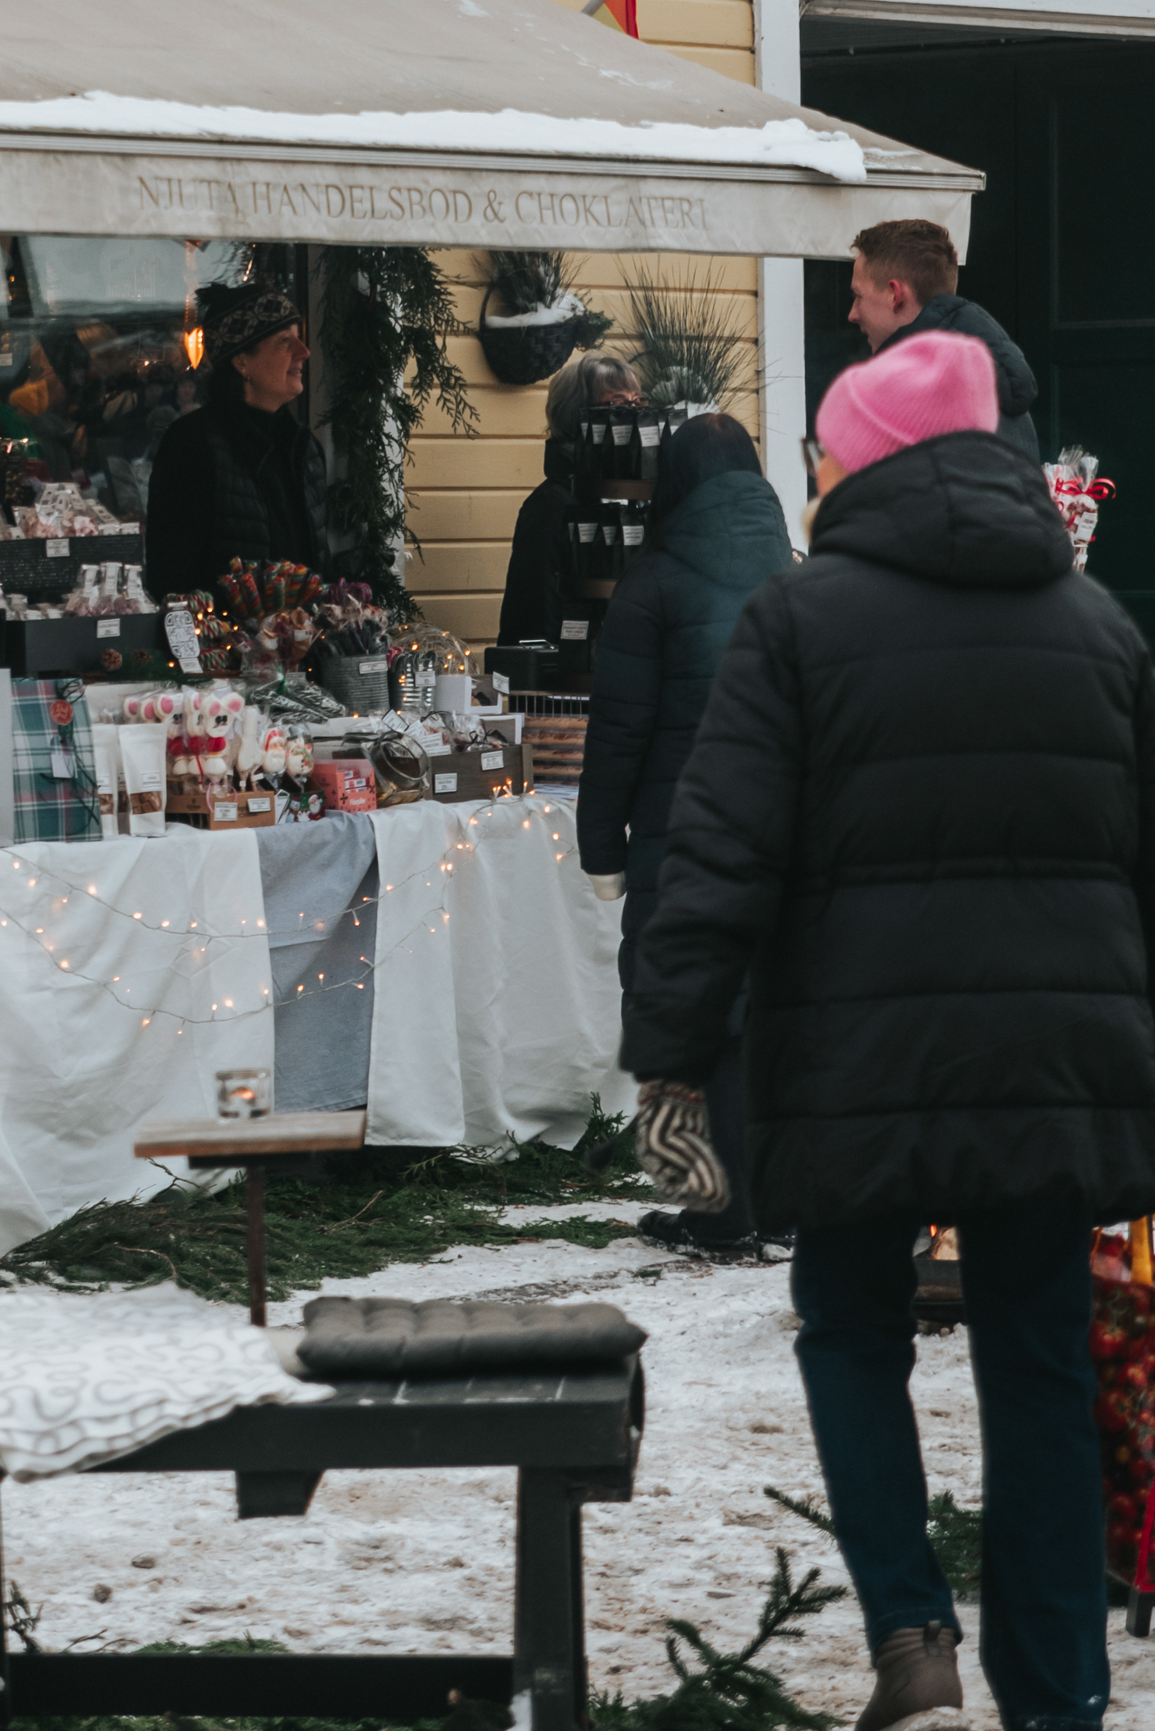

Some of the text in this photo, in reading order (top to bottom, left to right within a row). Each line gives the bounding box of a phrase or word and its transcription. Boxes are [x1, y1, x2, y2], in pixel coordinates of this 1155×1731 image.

[138, 176, 709, 231] NJUTA HANDELSBOD & CHOKLATERI
